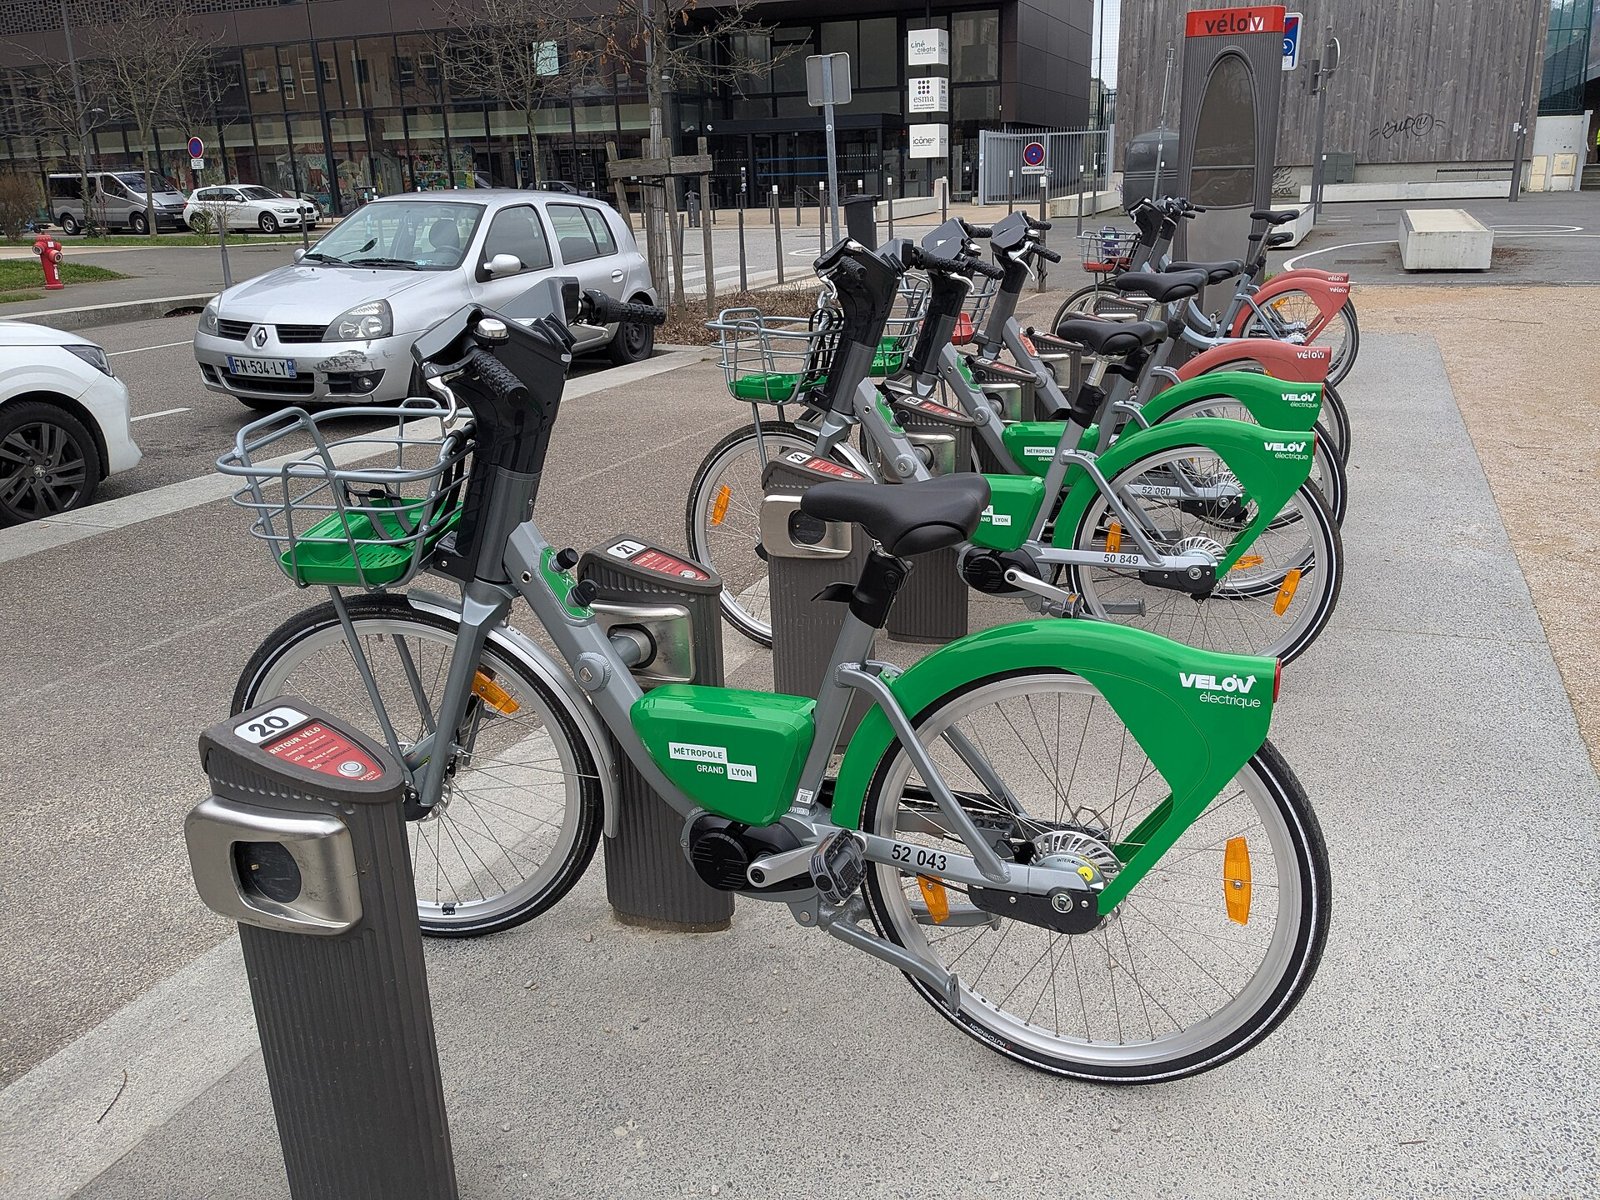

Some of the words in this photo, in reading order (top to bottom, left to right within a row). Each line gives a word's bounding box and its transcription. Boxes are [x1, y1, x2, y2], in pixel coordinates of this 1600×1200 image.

[1274, 452, 1309, 461] électrique
[1142, 486, 1152, 495] 52
[1155, 487, 1171, 496] 060
[616, 544, 637, 555] 21
[1103, 553, 1116, 563] 50
[1120, 555, 1139, 565] 849
[1199, 691, 1261, 709] électrique
[248, 715, 290, 738] 20
[269, 736, 301, 755] RETOUR
[300, 726, 321, 739] VÉLO
[673, 746, 723, 760] MÉTROPOLE
[696, 764, 725, 775] GRAND
[731, 767, 752, 777] LYON
[891, 844, 911, 863] 52
[917, 850, 947, 871] 043
